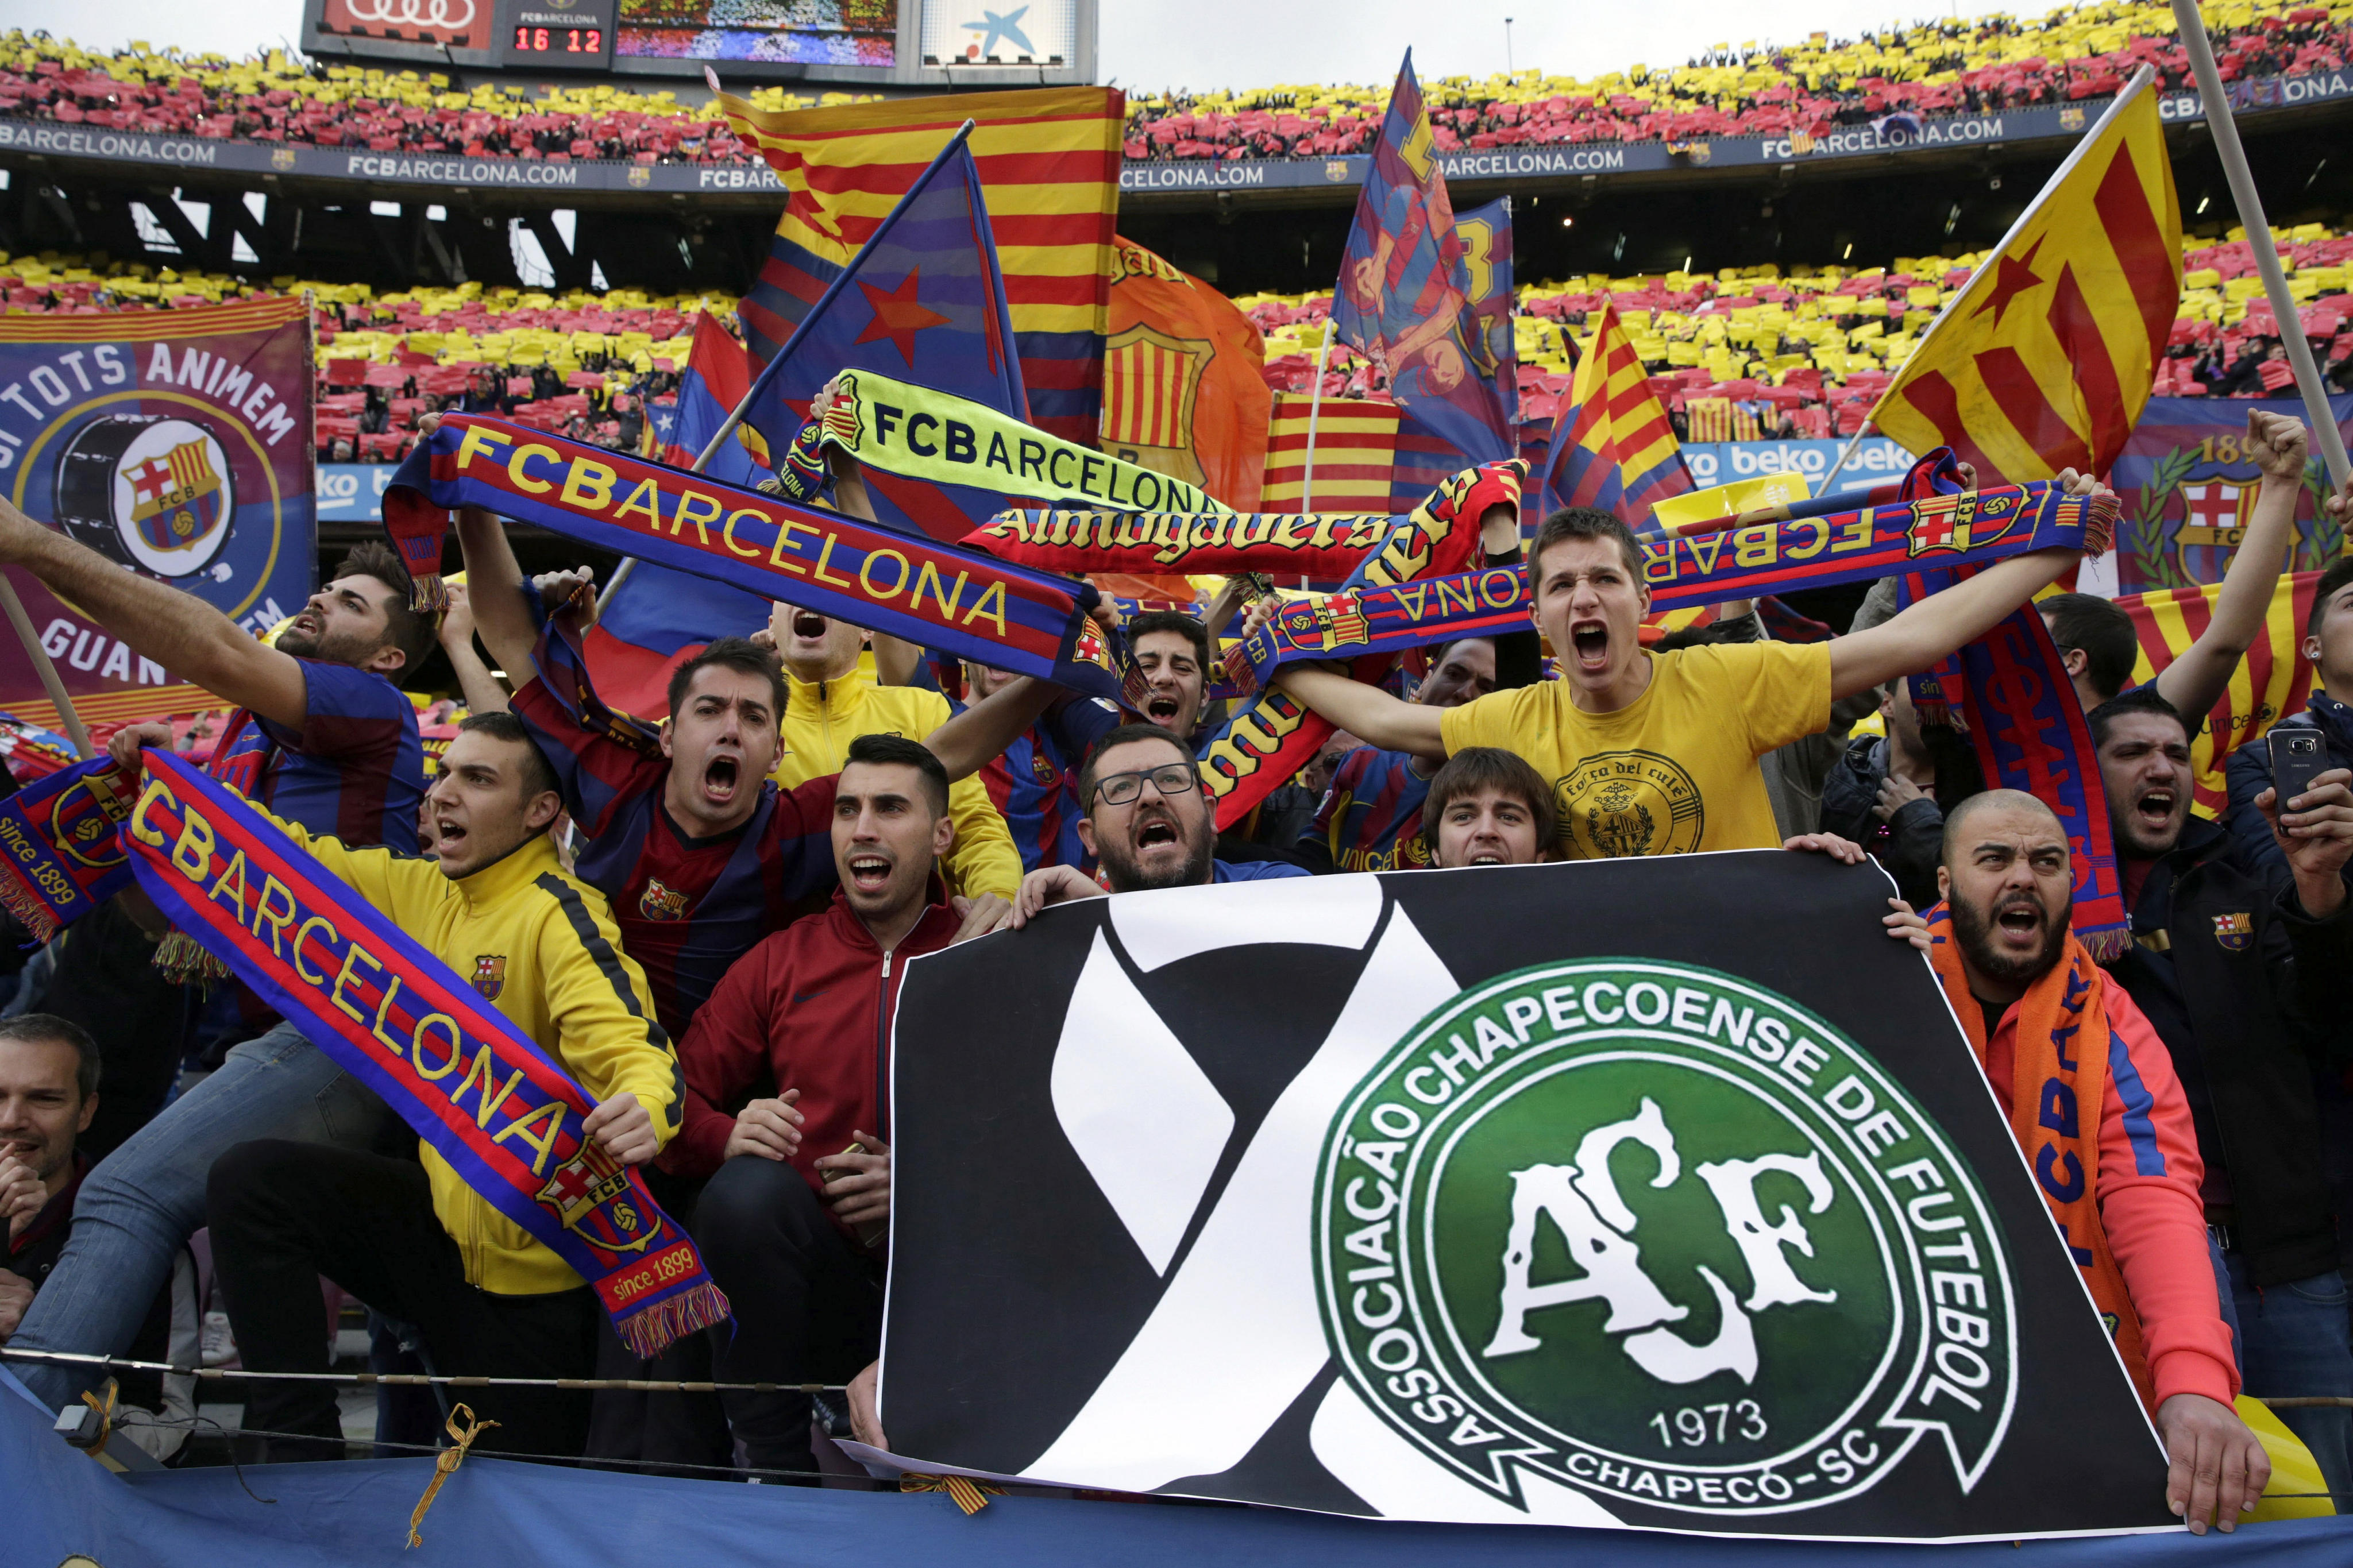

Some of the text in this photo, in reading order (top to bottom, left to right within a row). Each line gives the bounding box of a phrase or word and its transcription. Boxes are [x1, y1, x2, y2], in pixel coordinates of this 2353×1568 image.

[520, 11, 597, 25] FCBARCELONA
[515, 28, 601, 53] 16 12
[1762, 118, 2004, 159] FCARCELONA.COM
[348, 156, 577, 184] FCBARCELONA.COM
[0, 345, 126, 420] TOTS
[146, 343, 296, 447] ANIMEM
[1731, 444, 1826, 474] beko
[158, 486, 196, 510] FCB
[316, 468, 359, 497] ko
[457, 424, 1006, 637] FCBARCELONA
[1314, 607, 1332, 632] FCB
[1247, 631, 1267, 664] CB
[1920, 679, 1940, 694] sin
[2200, 712, 2251, 735] unice
[1615, 762, 1641, 775] del
[0, 816, 76, 905] since 1899
[1337, 838, 1402, 872] unicef
[131, 778, 569, 1177] CBARCELONA
[588, 1173, 629, 1206] FCB
[1342, 980, 1991, 1449] ASSOCIAÇÃO CHAPECOENSE DE FUTEBOL
[614, 1246, 694, 1301] since 1899
[1649, 1400, 1768, 1449] 1973
